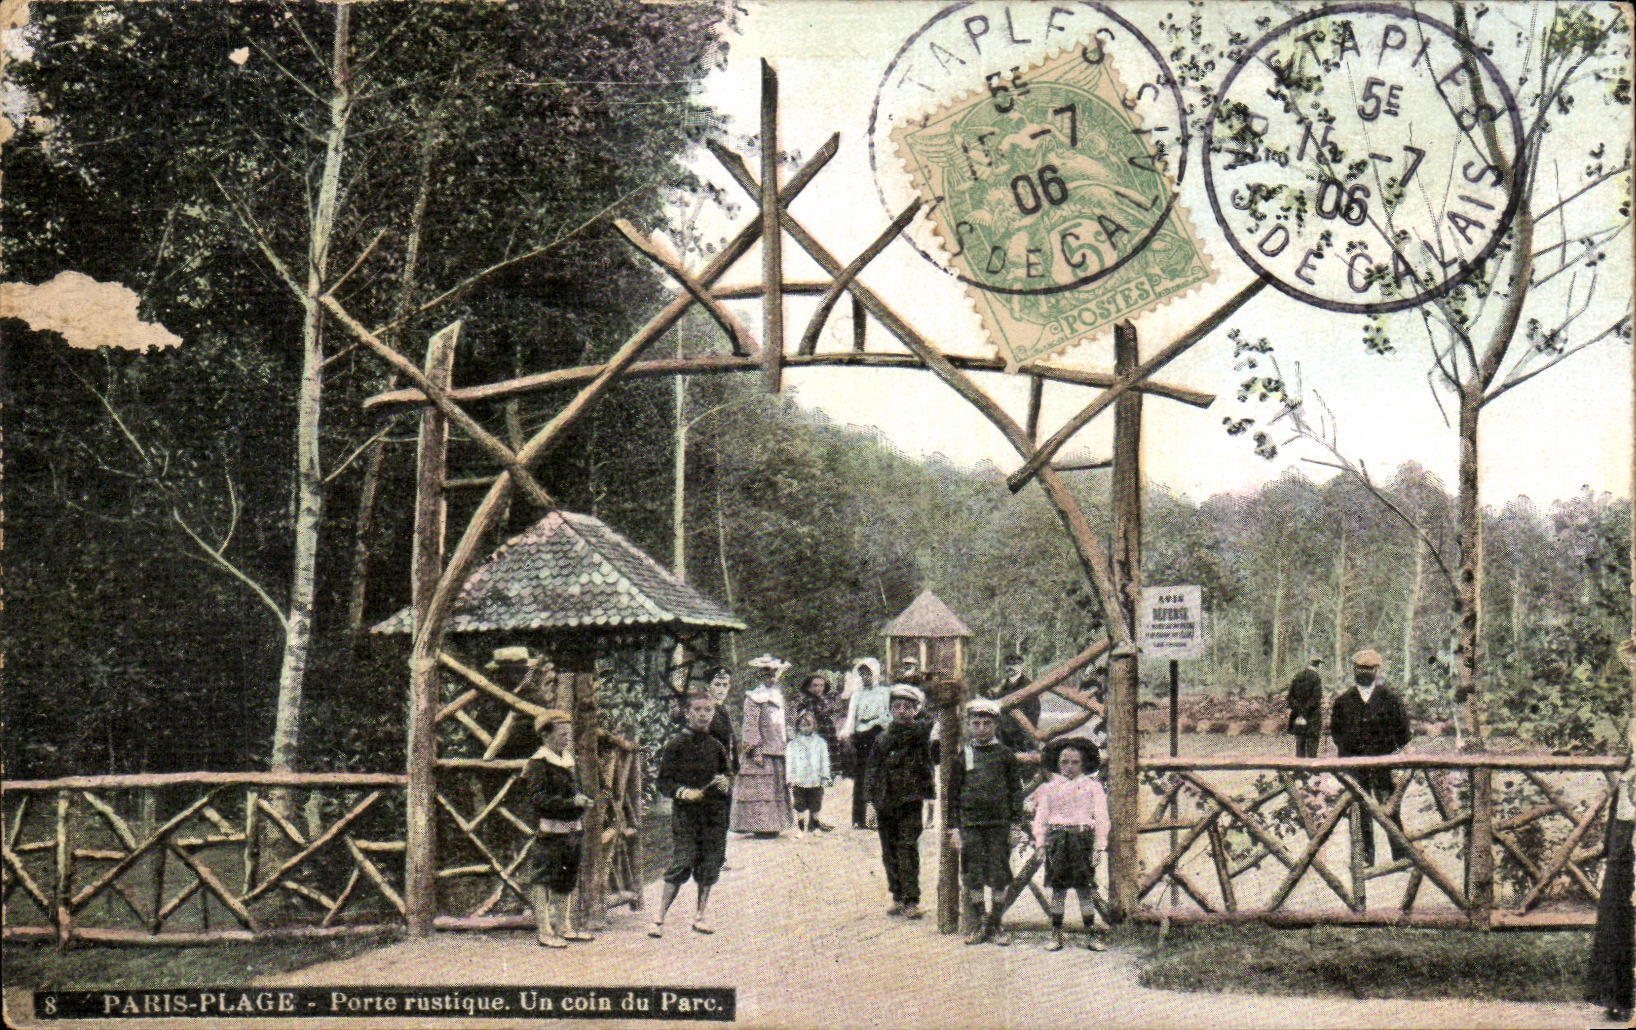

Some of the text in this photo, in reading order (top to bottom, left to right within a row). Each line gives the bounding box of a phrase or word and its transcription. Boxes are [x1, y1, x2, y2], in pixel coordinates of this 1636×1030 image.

[1010, 164, 1069, 216] 06
[1315, 178, 1371, 227] 06
[1062, 280, 1151, 335] POSTES
